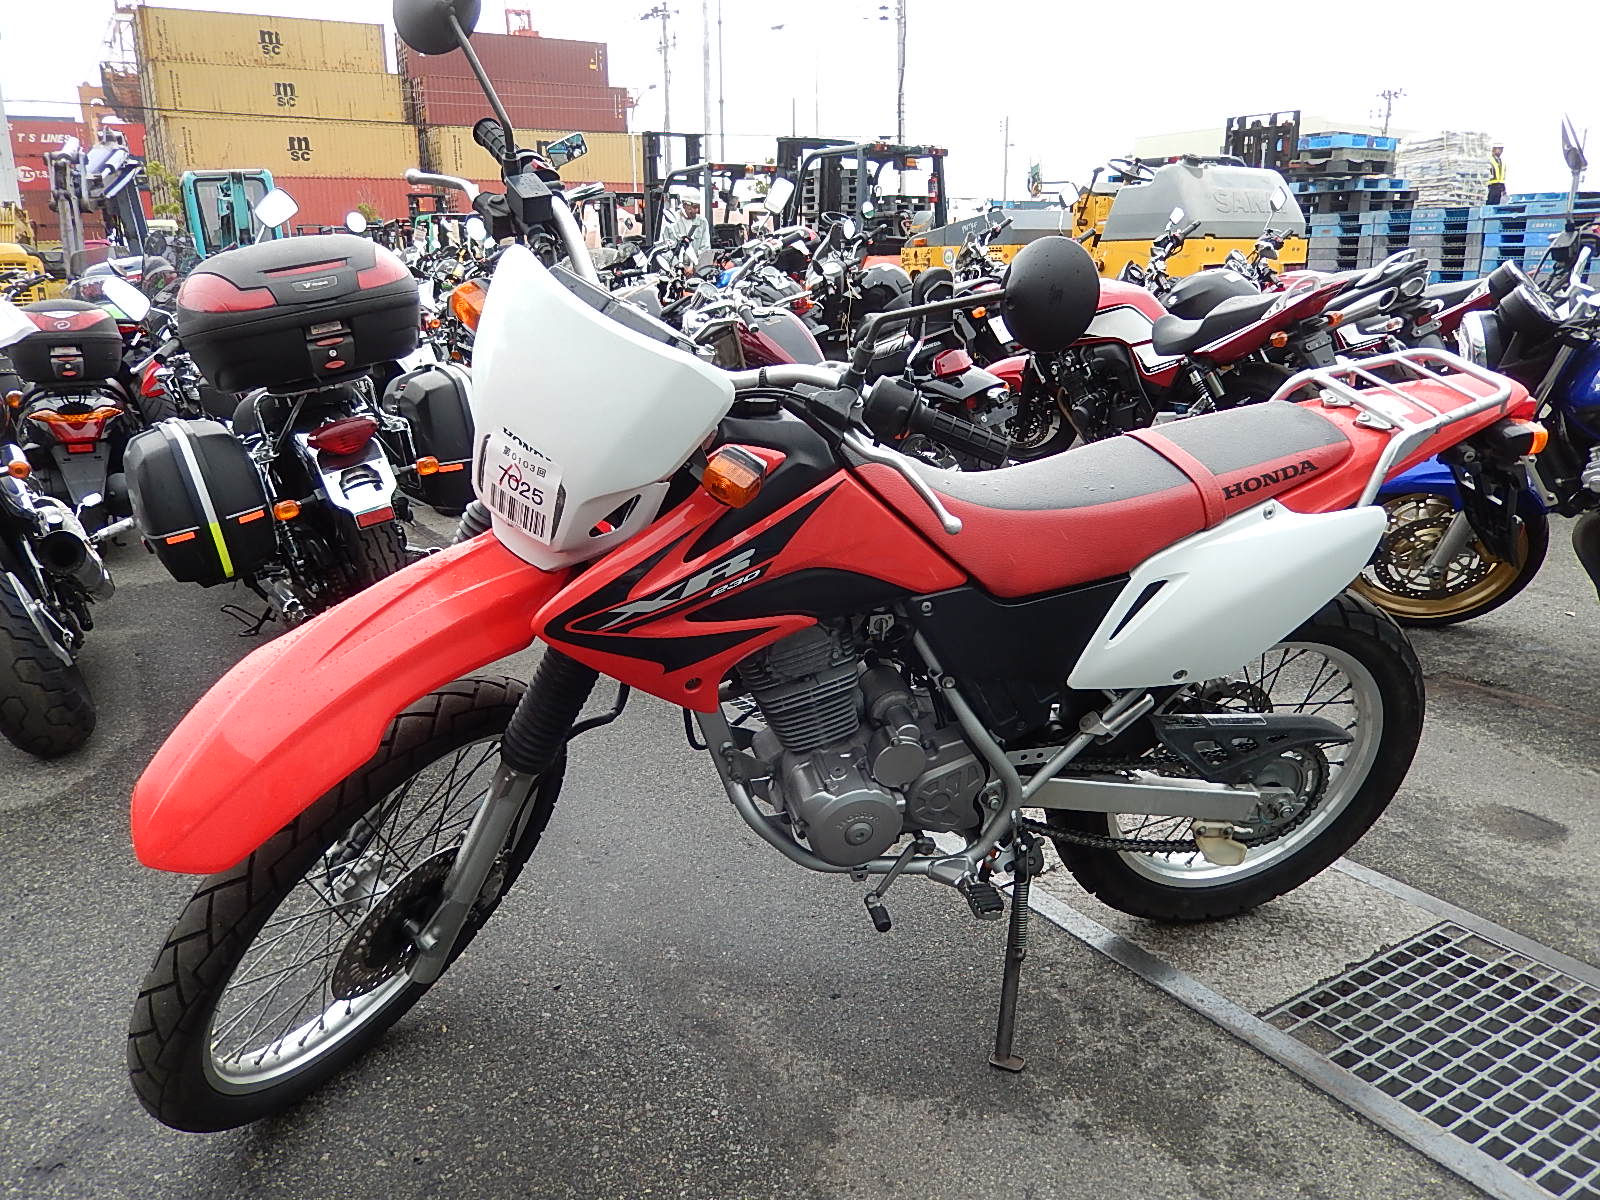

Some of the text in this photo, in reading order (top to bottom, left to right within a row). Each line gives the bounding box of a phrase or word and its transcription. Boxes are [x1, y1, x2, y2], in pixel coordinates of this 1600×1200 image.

[17, 133, 25, 142] T
[28, 133, 37, 143] S
[498, 464, 544, 506] 7025
[1222, 460, 1319, 500] HONDA
[598, 548, 755, 630] XR
[710, 569, 761, 598] 230
